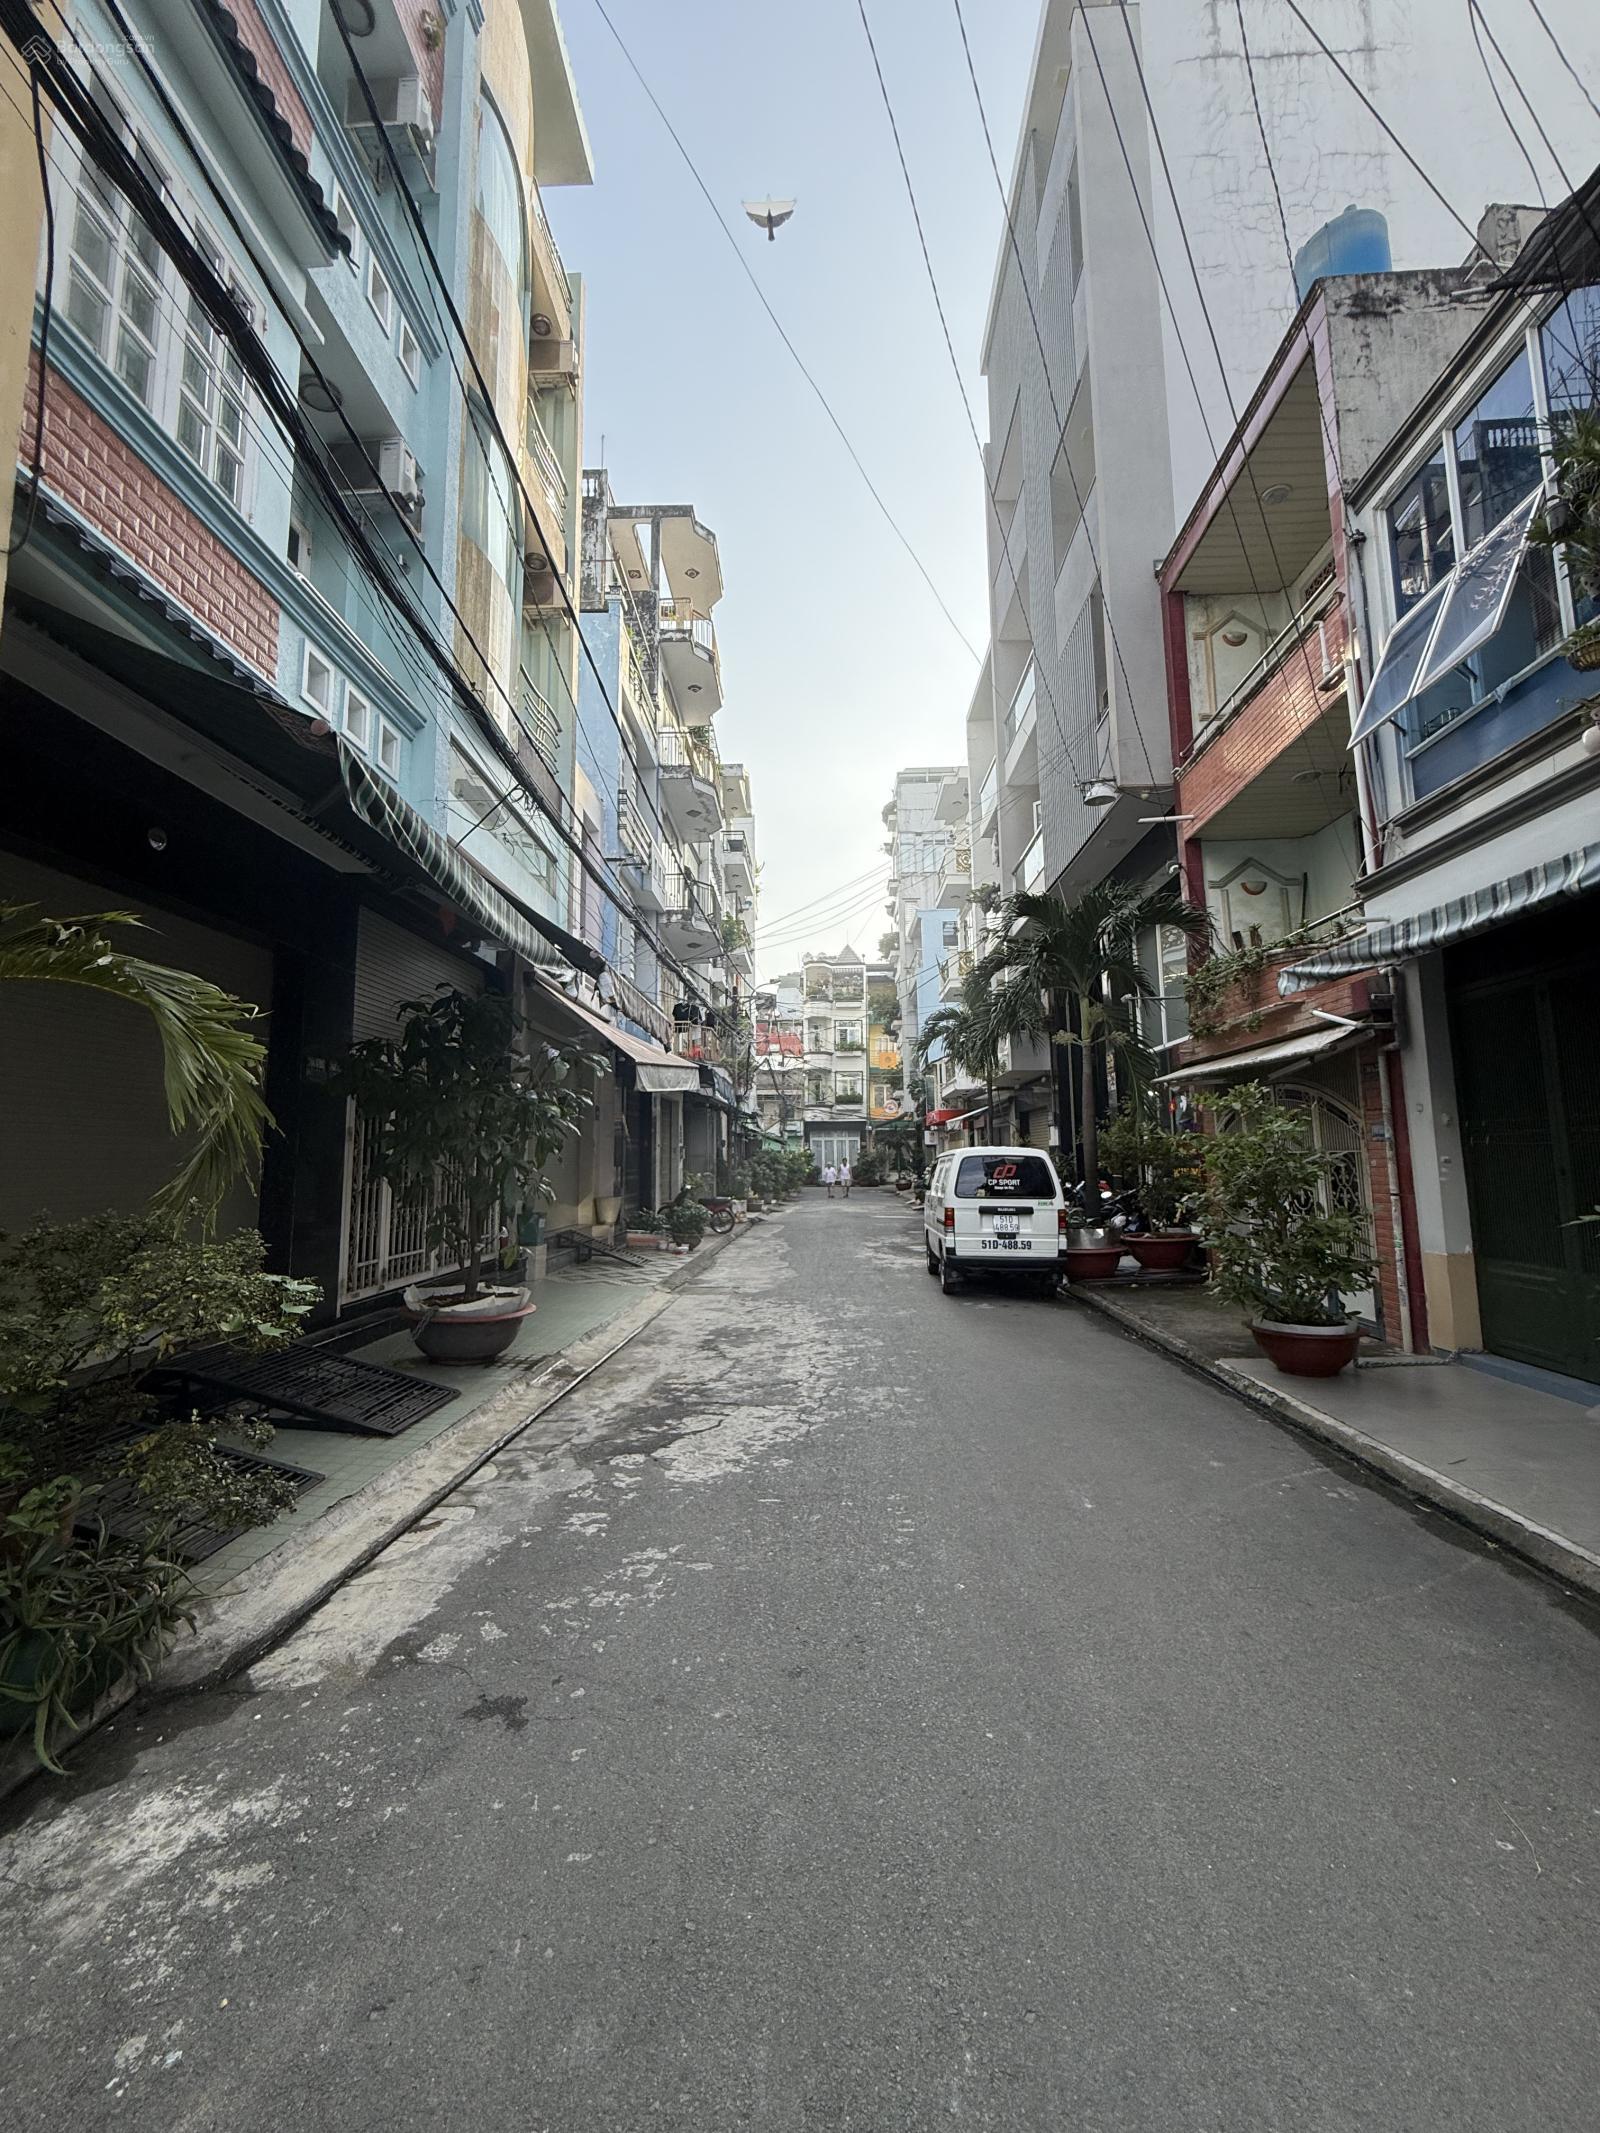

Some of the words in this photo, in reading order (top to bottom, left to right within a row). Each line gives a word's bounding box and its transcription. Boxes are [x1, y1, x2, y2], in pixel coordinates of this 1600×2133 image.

[999, 1215, 1014, 1223] 51D
[995, 1223, 1019, 1232] 488.59
[981, 1240, 1032, 1250] 51D-488.59
